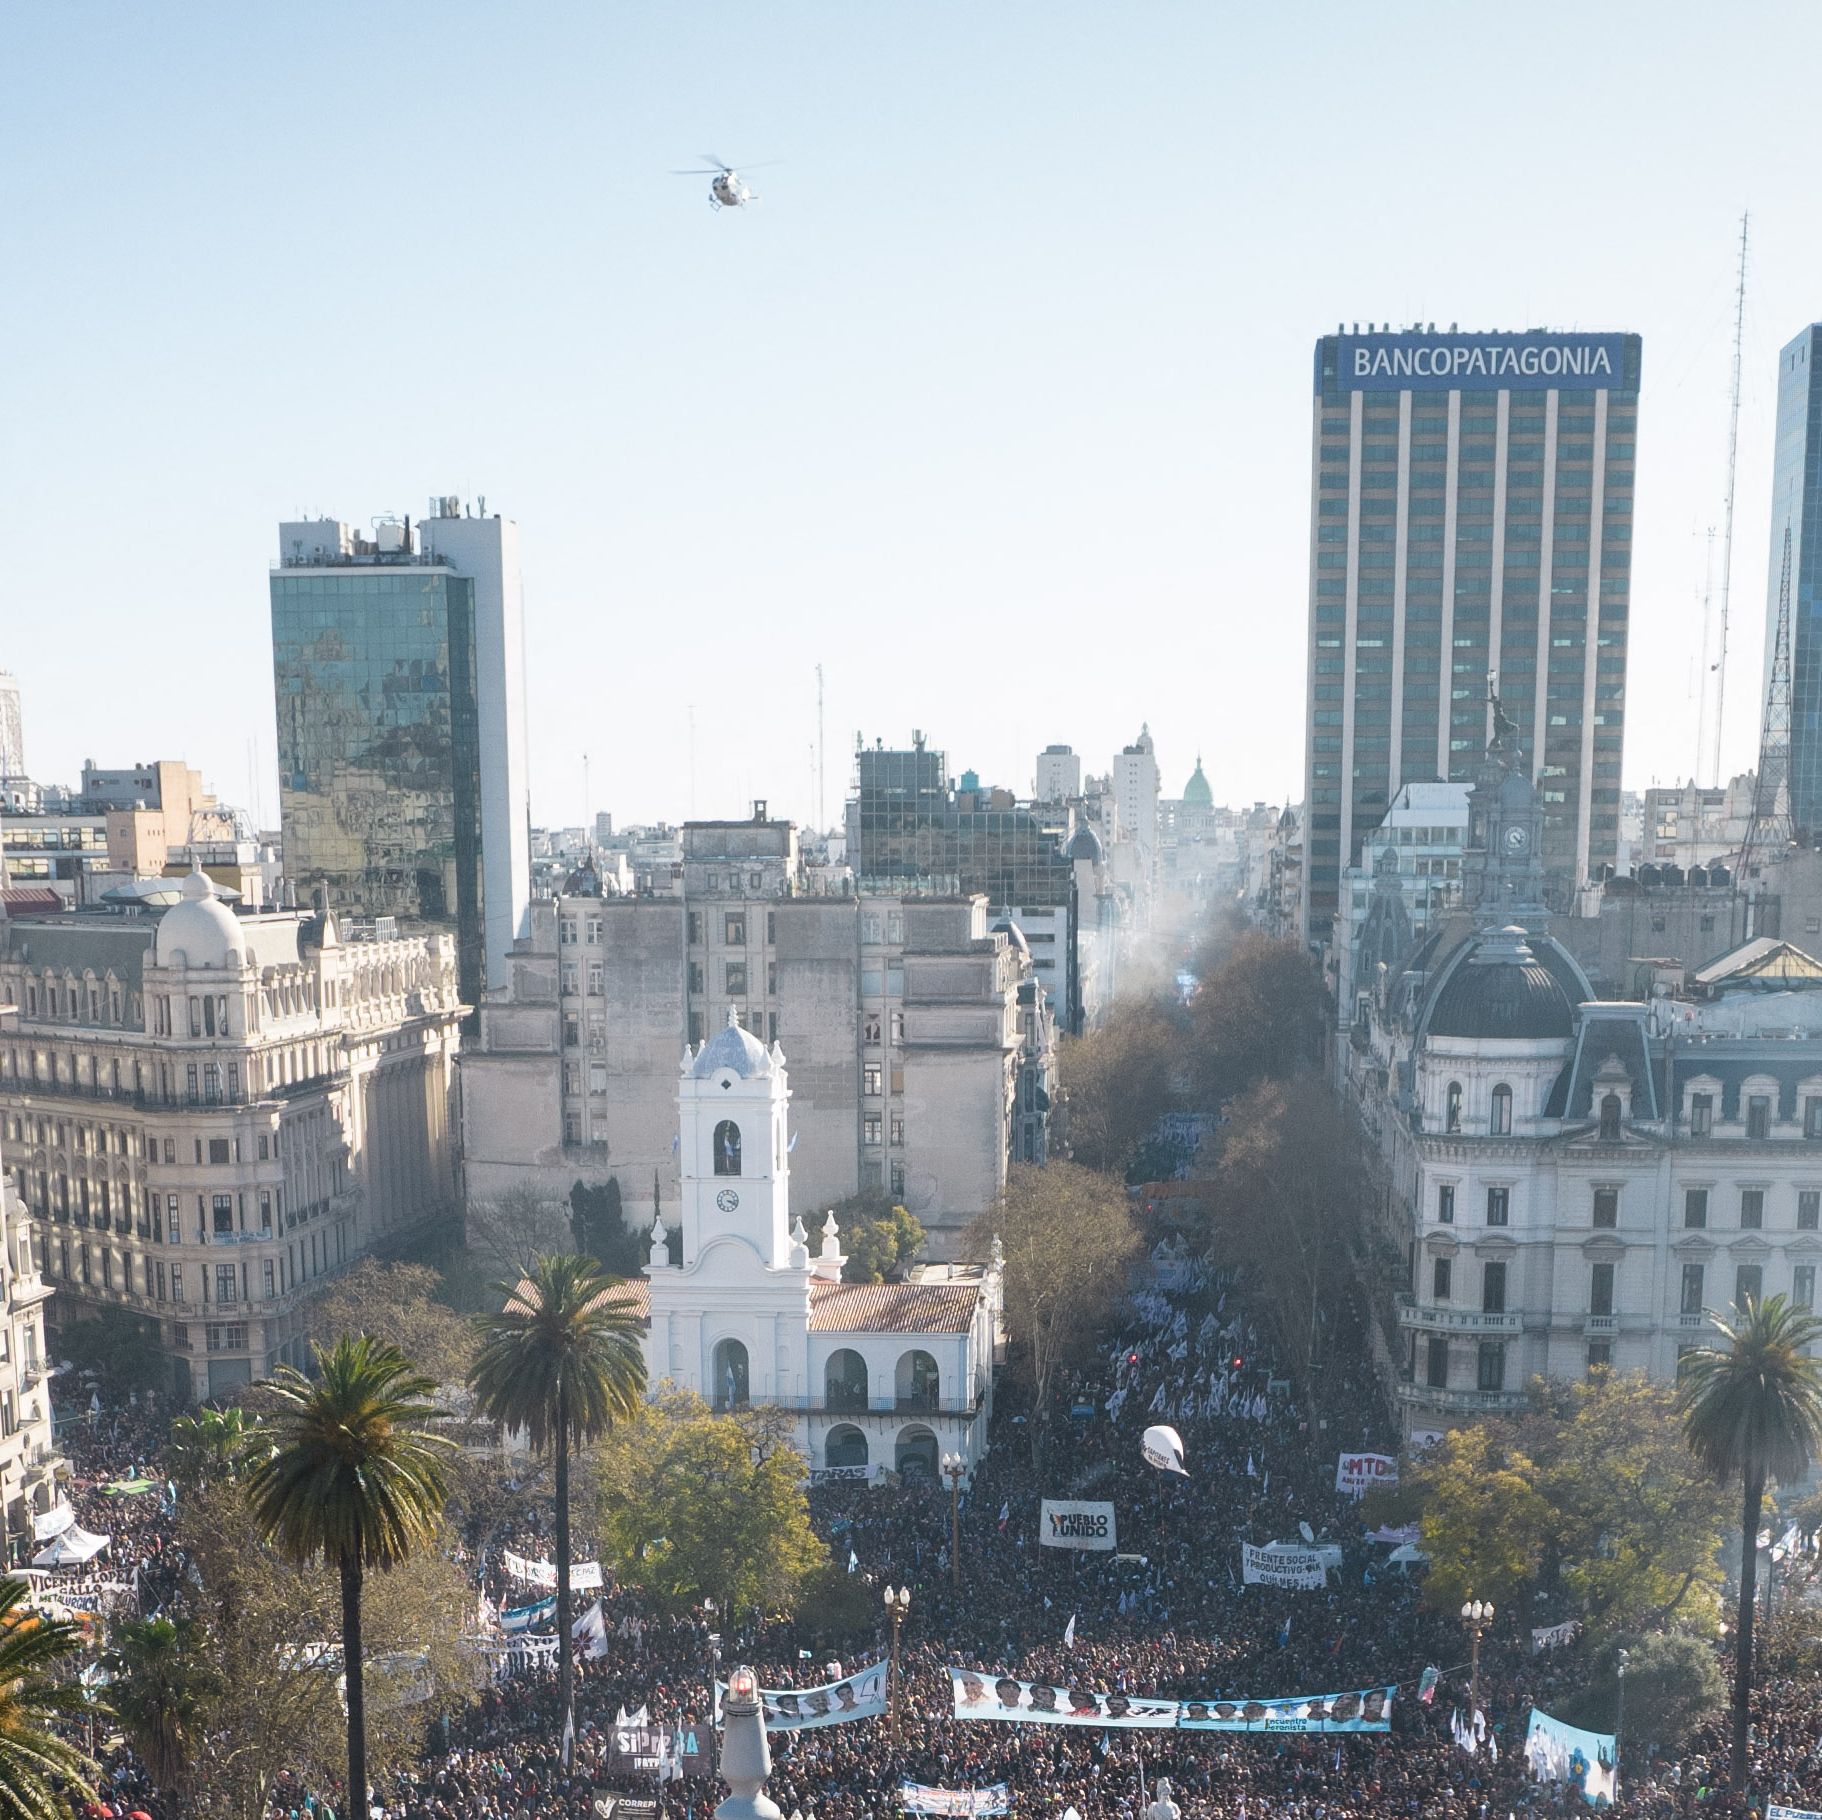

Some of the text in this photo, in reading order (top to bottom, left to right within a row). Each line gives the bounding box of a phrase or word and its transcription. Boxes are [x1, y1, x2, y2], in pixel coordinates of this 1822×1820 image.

[1354, 346, 1611, 376] BANCOPATAGONIA
[1060, 1514, 1108, 1526] PUEBLO
[1060, 1526, 1108, 1537] UNIDO
[1250, 1549, 1316, 1565] FRENTE SOCIAL
[28, 1573, 81, 1593] VICENTE
[1260, 1573, 1299, 1587] QUILMES
[59, 1584, 103, 1595] GALLO
[618, 1798, 657, 1809] CORREPI
[1769, 1807, 1781, 1818] EL
